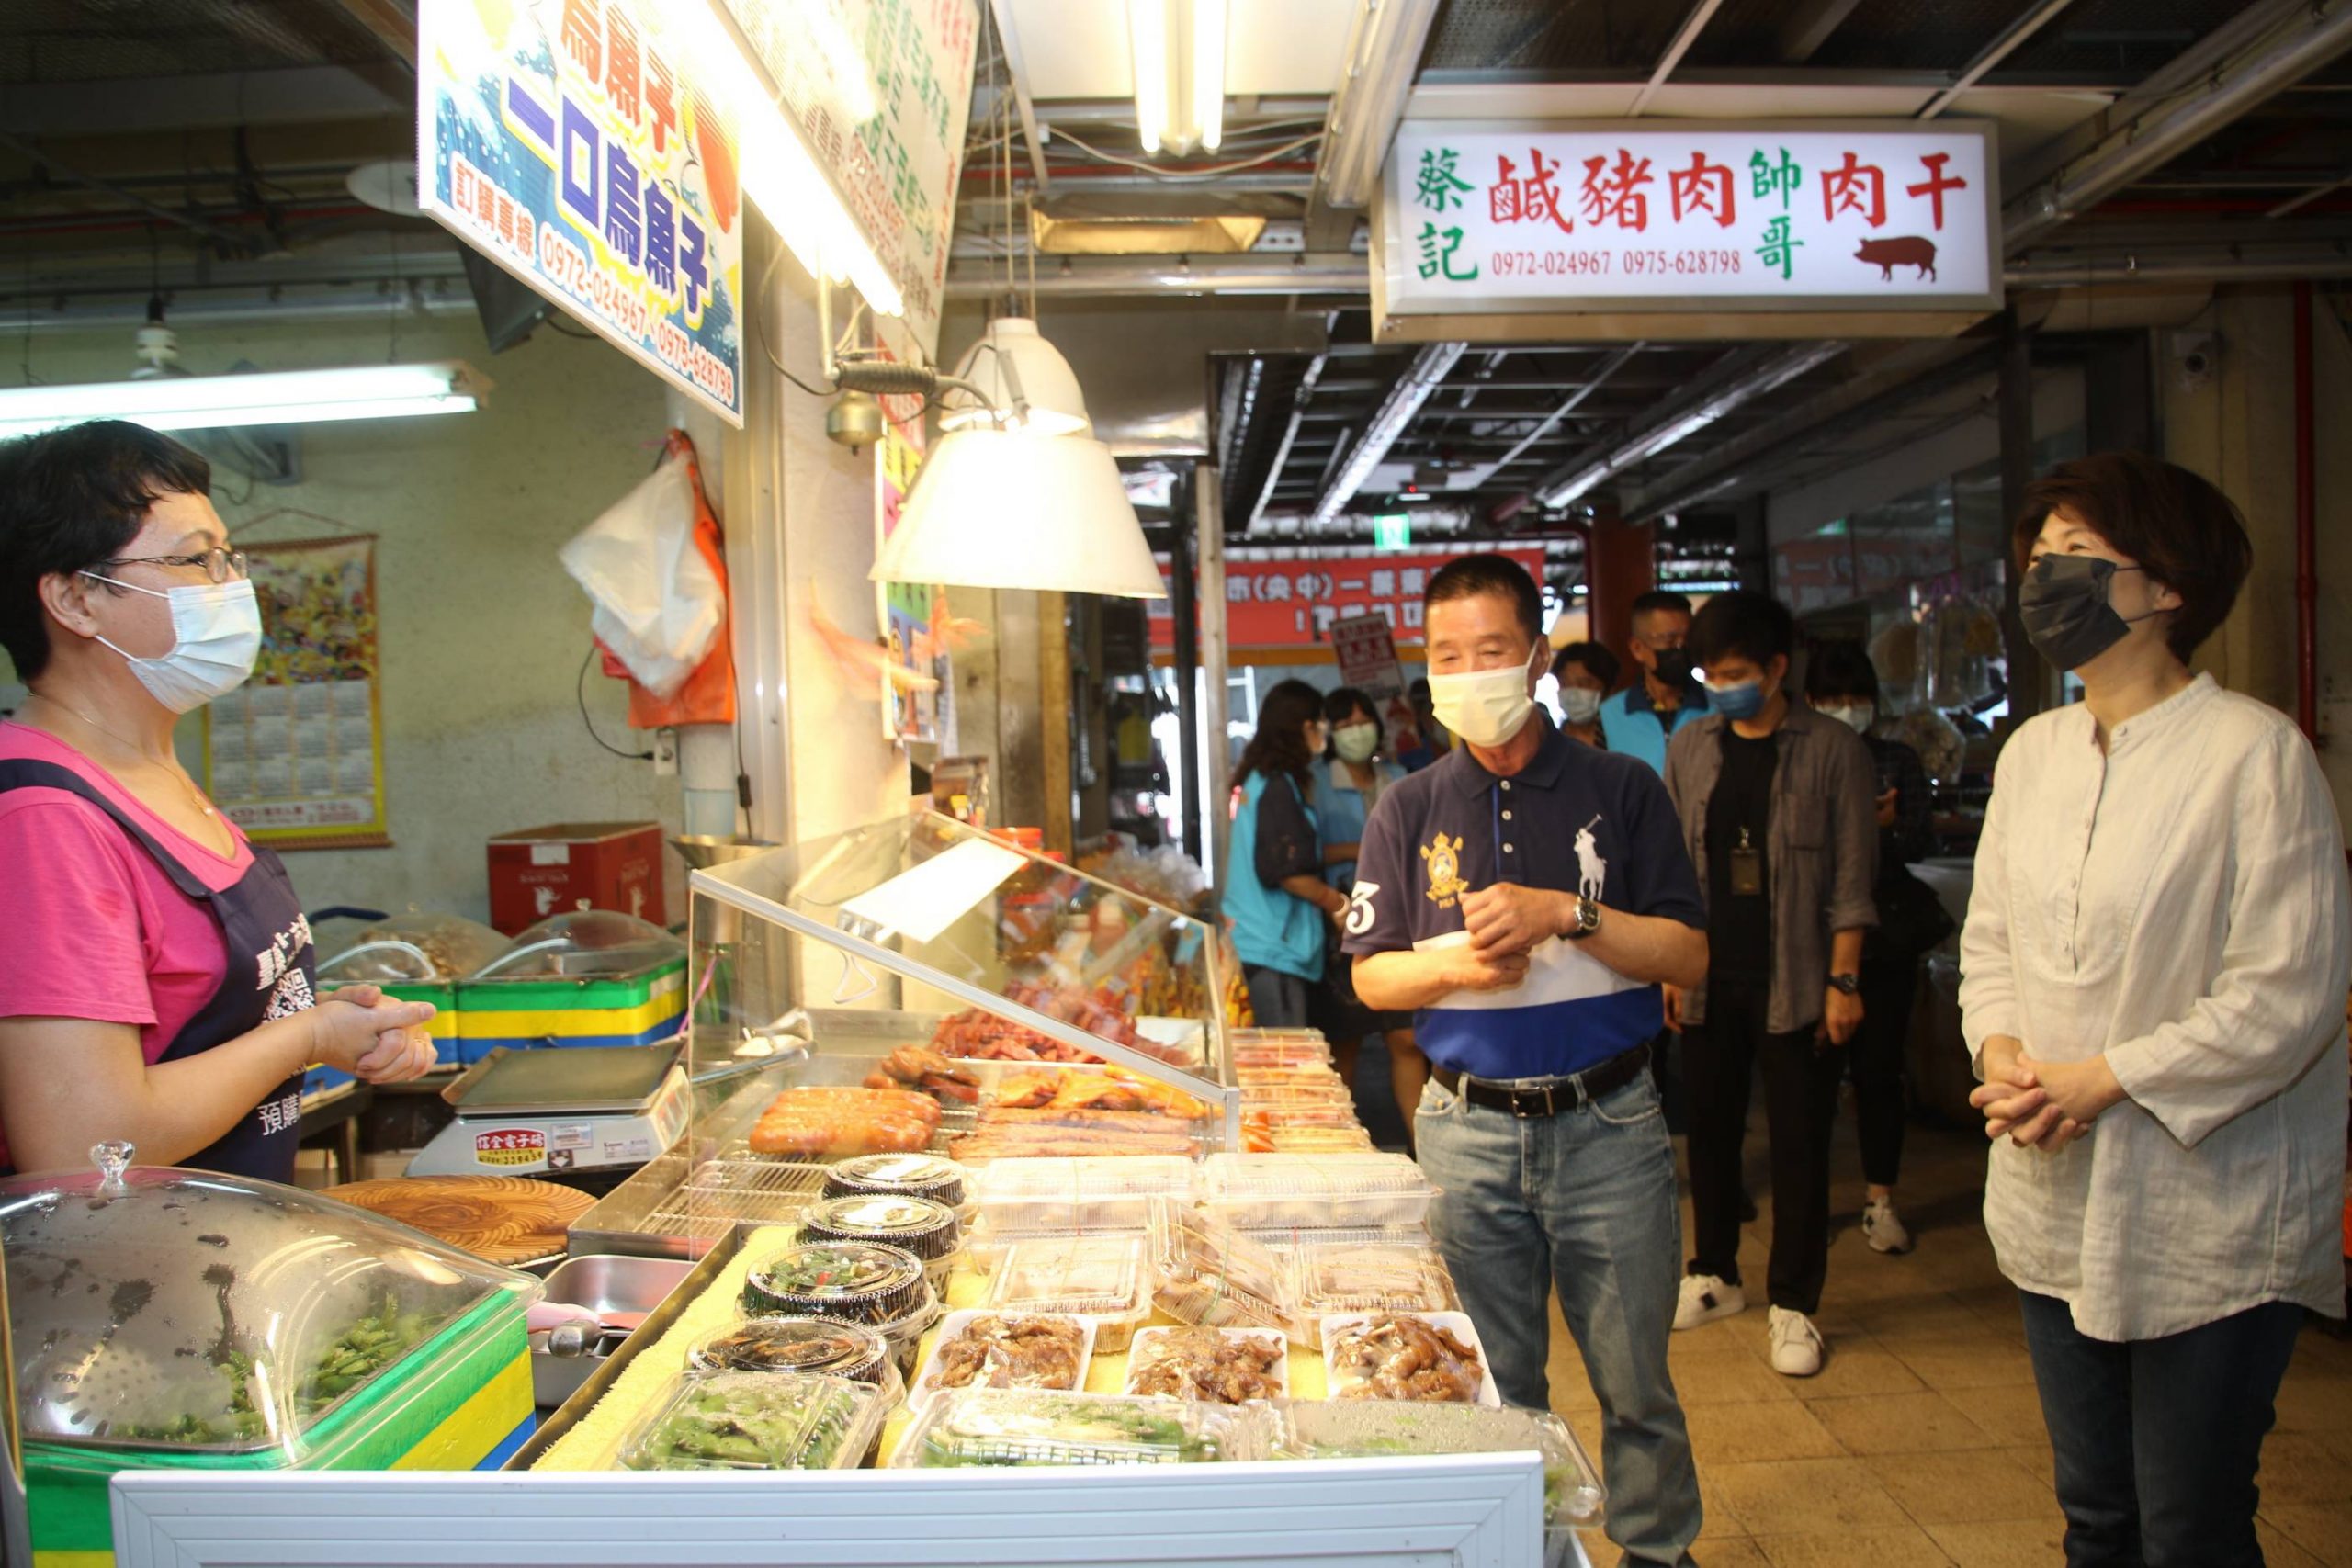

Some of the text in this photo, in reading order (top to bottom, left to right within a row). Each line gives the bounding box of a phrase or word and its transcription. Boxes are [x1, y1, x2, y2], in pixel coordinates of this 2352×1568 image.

[455, 160, 535, 259] 訂購專線
[1414, 146, 1478, 282] 蔡記
[1487, 146, 1735, 234] 鹹豬肉
[1748, 145, 1804, 280] 帥哥
[1819, 151, 1968, 231] 肉干
[1492, 248, 1741, 276] 0972-024967 0975-628798
[1346, 880, 1380, 935] 3
